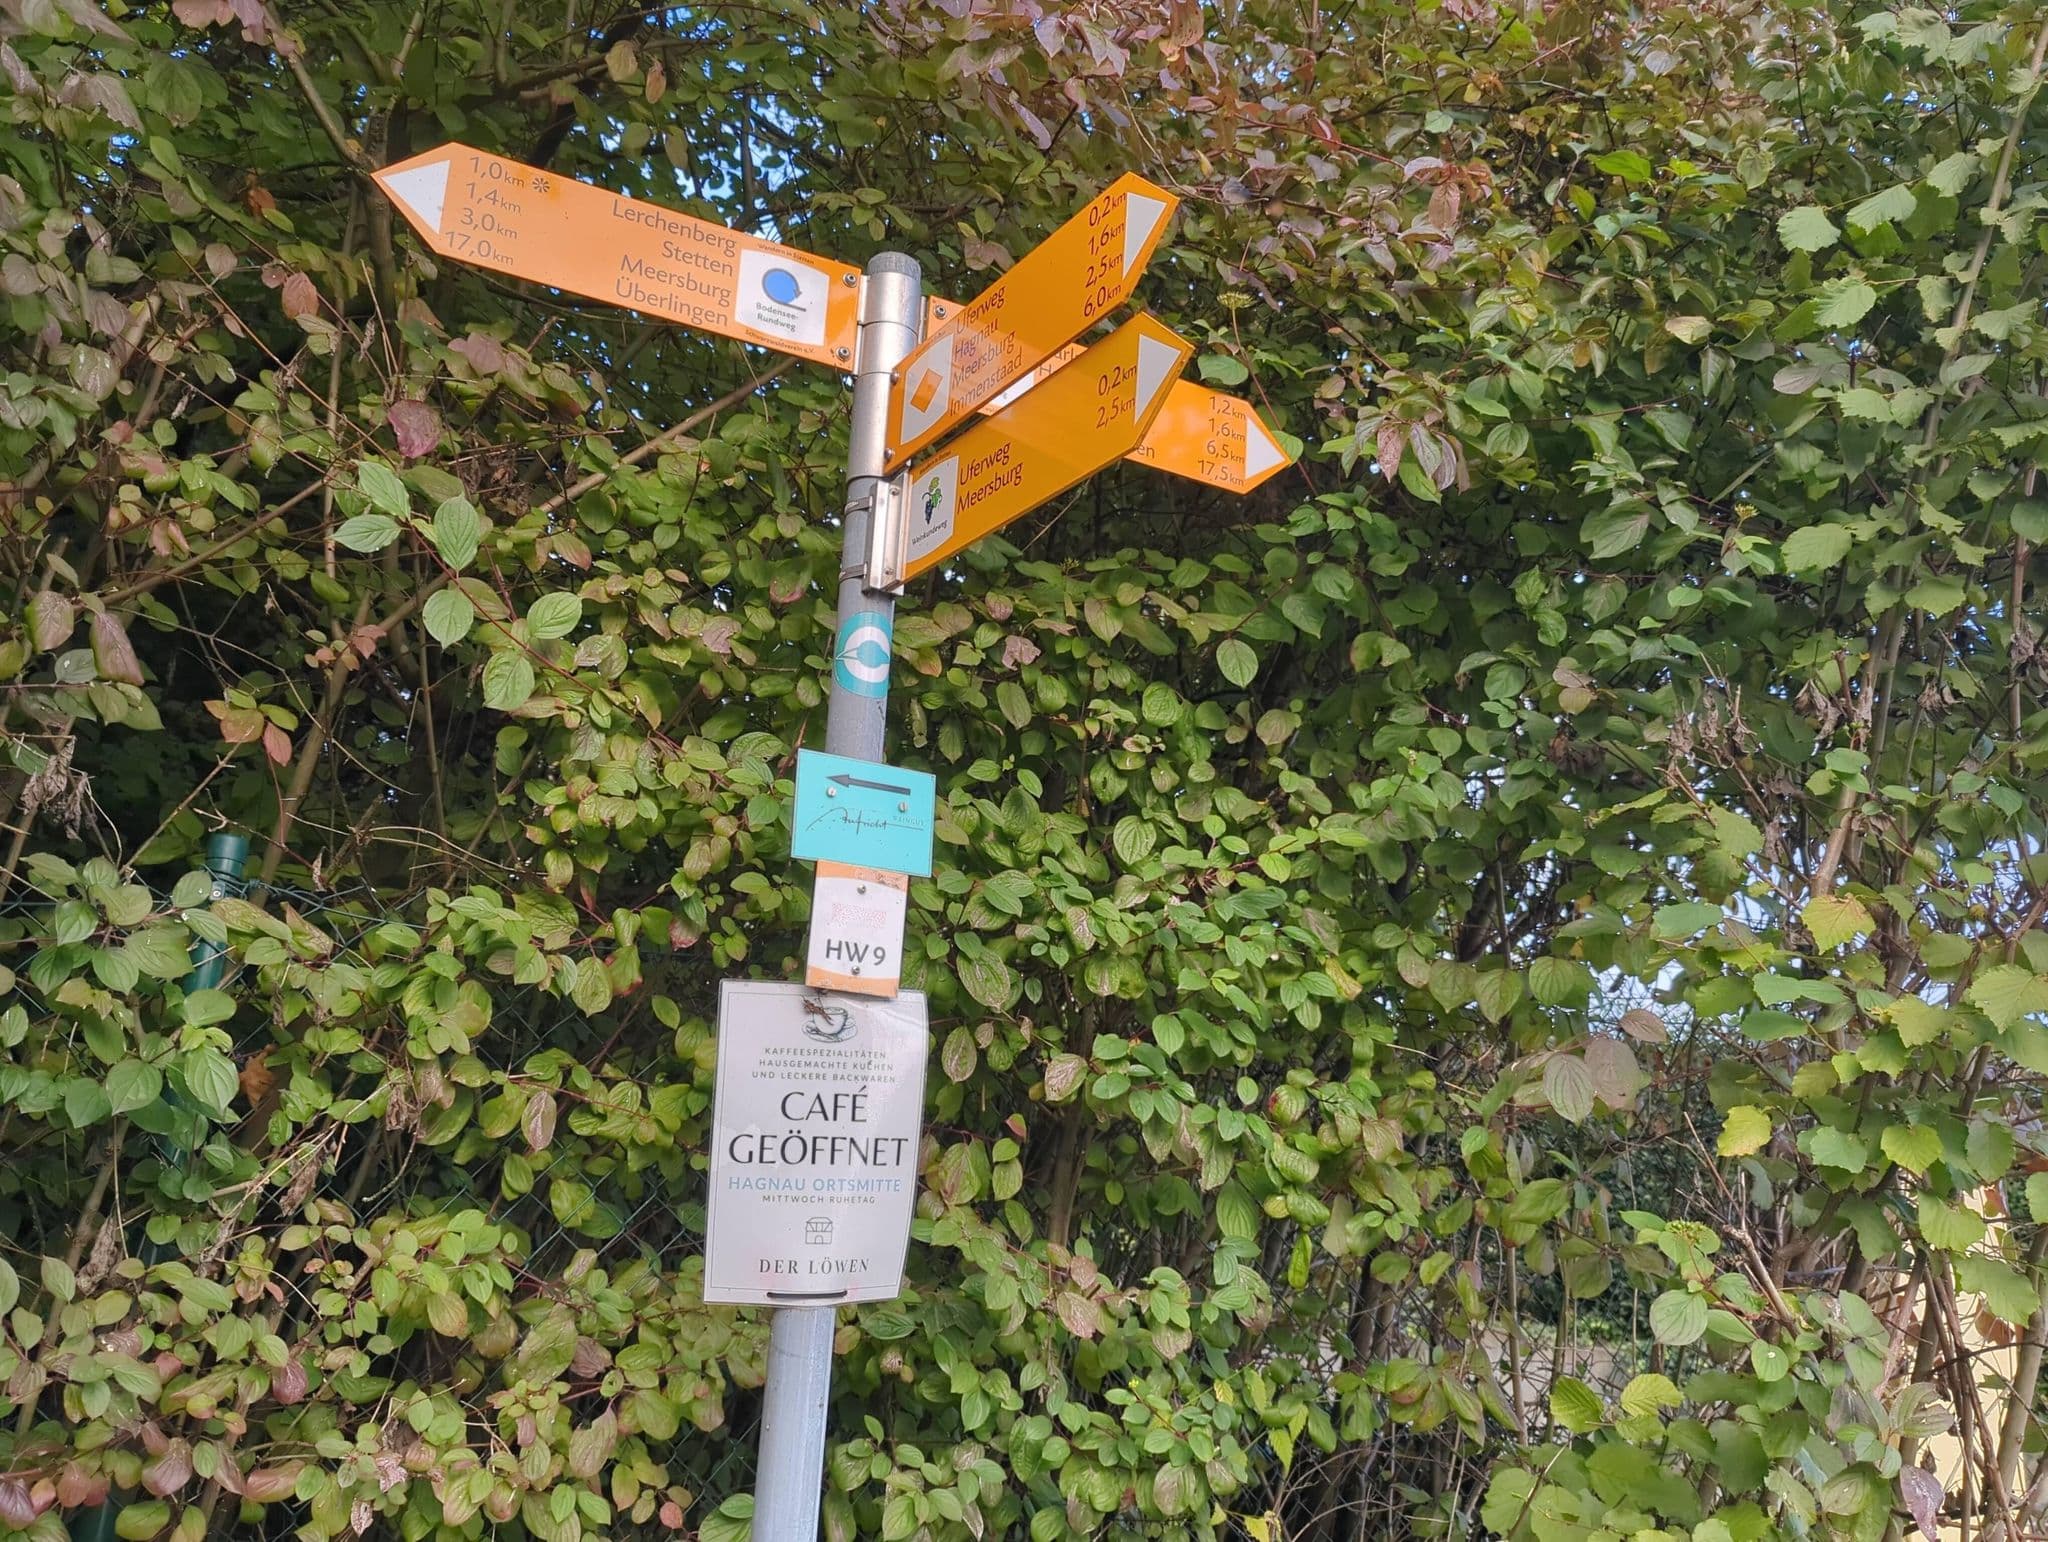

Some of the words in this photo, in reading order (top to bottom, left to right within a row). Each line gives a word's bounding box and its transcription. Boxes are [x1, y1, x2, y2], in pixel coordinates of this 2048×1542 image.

[613, 199, 736, 257] Lerchenberg
[662, 240, 733, 277] Stetten
[620, 254, 730, 307] Meersburg
[616, 275, 727, 326] Überlingen
[756, 302, 799, 319] Bodensee-
[956, 285, 1006, 334] Uferweg
[757, 313, 796, 333] Rundweg
[953, 318, 998, 362] Hagnau
[952, 330, 1015, 390] Meersburg
[950, 348, 1022, 416] Immenstaad
[960, 442, 1011, 486] Uferweg
[957, 462, 1023, 515] Meersburg
[752, 1071, 775, 1079] UND
[780, 1072, 828, 1081] LECKERE
[832, 1073, 896, 1083] BACKWAREN
[759, 1059, 848, 1070] HAUSGEMACHTE
[781, 1085, 868, 1123] CAFÉ
[729, 1129, 909, 1167] GEÖFFNET
[728, 1176, 806, 1191] HAGNAU
[812, 1178, 901, 1192] ORTSMITTE
[762, 1195, 824, 1203] MITTWOCH
[829, 1196, 875, 1204] RUHETAG
[759, 1259, 798, 1274] DER
[808, 1257, 870, 1274] LÖWEN
